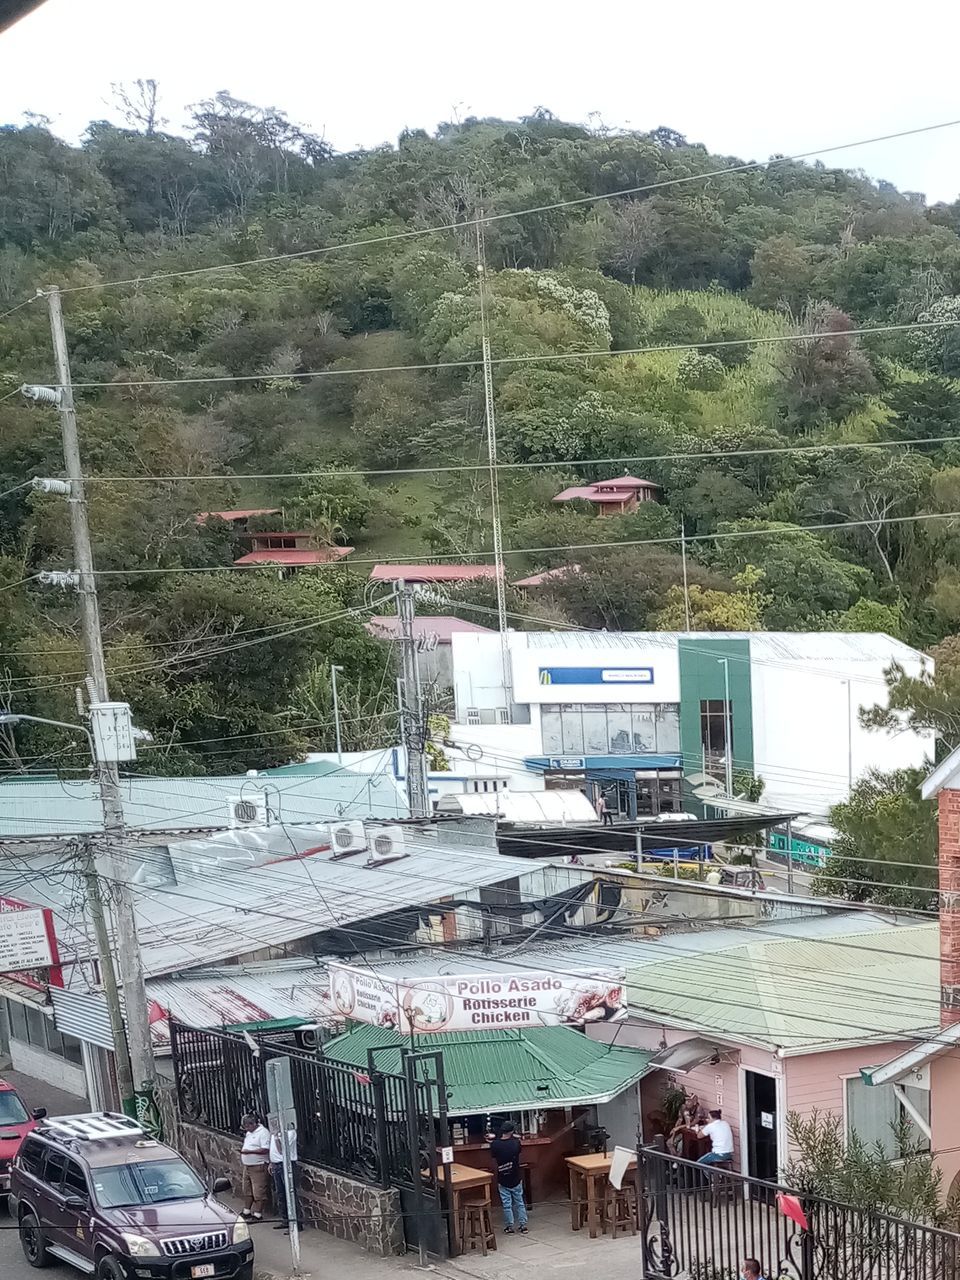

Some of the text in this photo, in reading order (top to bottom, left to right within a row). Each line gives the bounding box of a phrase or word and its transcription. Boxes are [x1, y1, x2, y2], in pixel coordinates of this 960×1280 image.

[355, 976, 372, 989] Pollo
[457, 980, 501, 995] Pollo
[508, 977, 562, 992] Asado
[463, 996, 537, 1011] Rotisserie
[471, 1011, 530, 1024] Chicken
